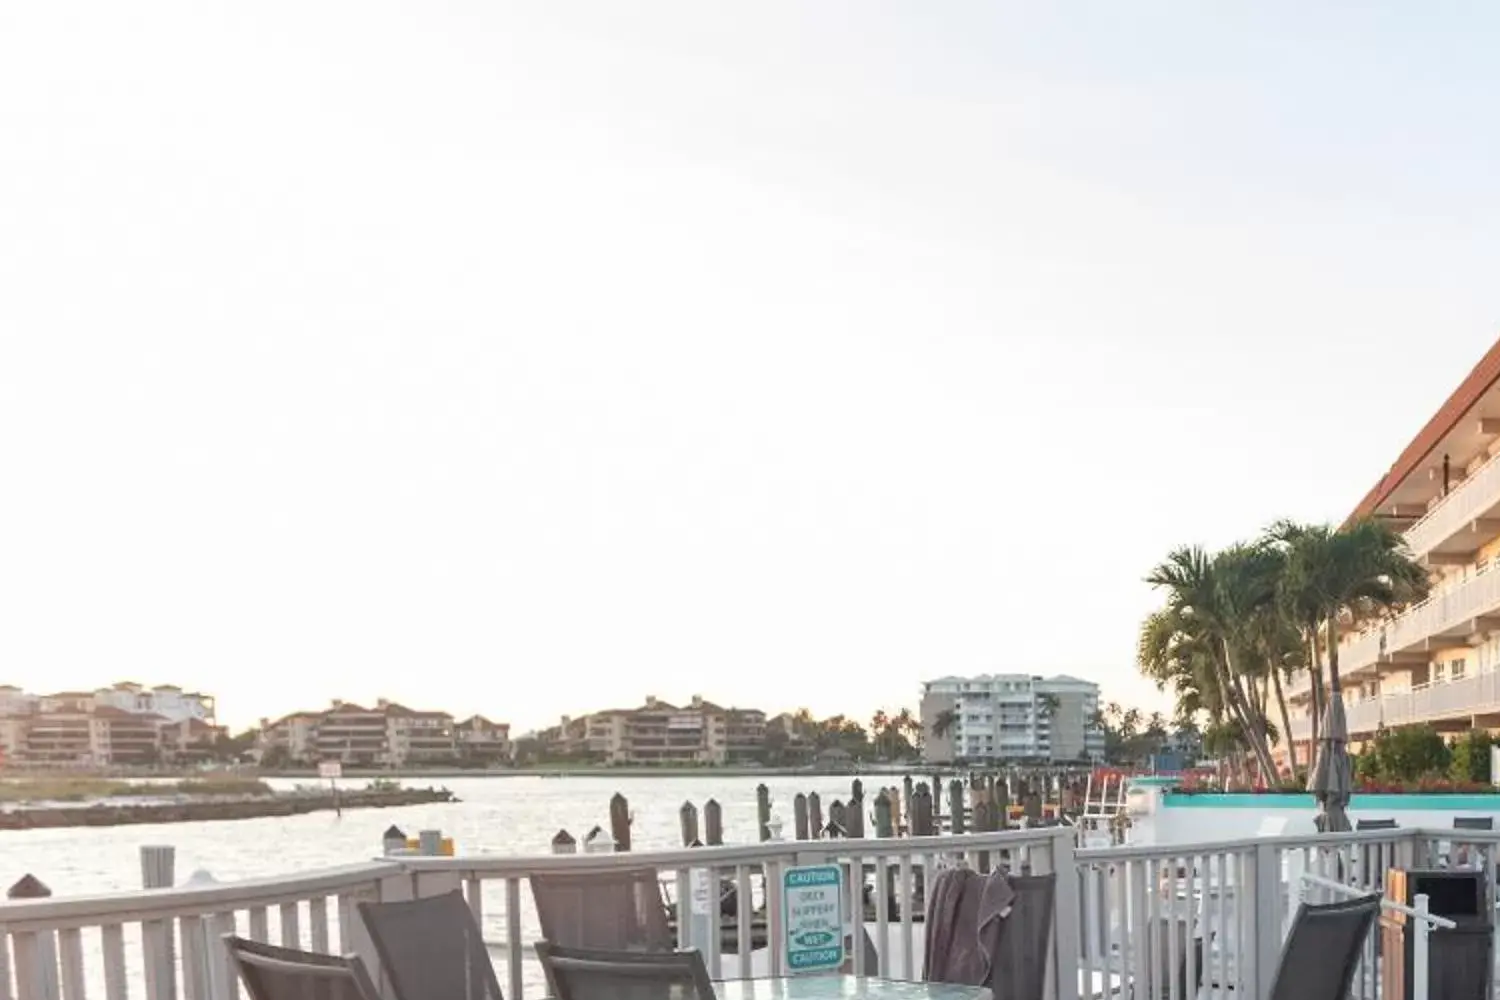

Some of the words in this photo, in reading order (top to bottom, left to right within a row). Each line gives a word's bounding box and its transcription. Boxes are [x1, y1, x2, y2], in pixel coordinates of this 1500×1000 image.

[789, 871, 835, 884] CAUTION
[799, 891, 825, 902] DECK
[803, 934, 826, 945] WET
[793, 951, 837, 964] CAUTION
